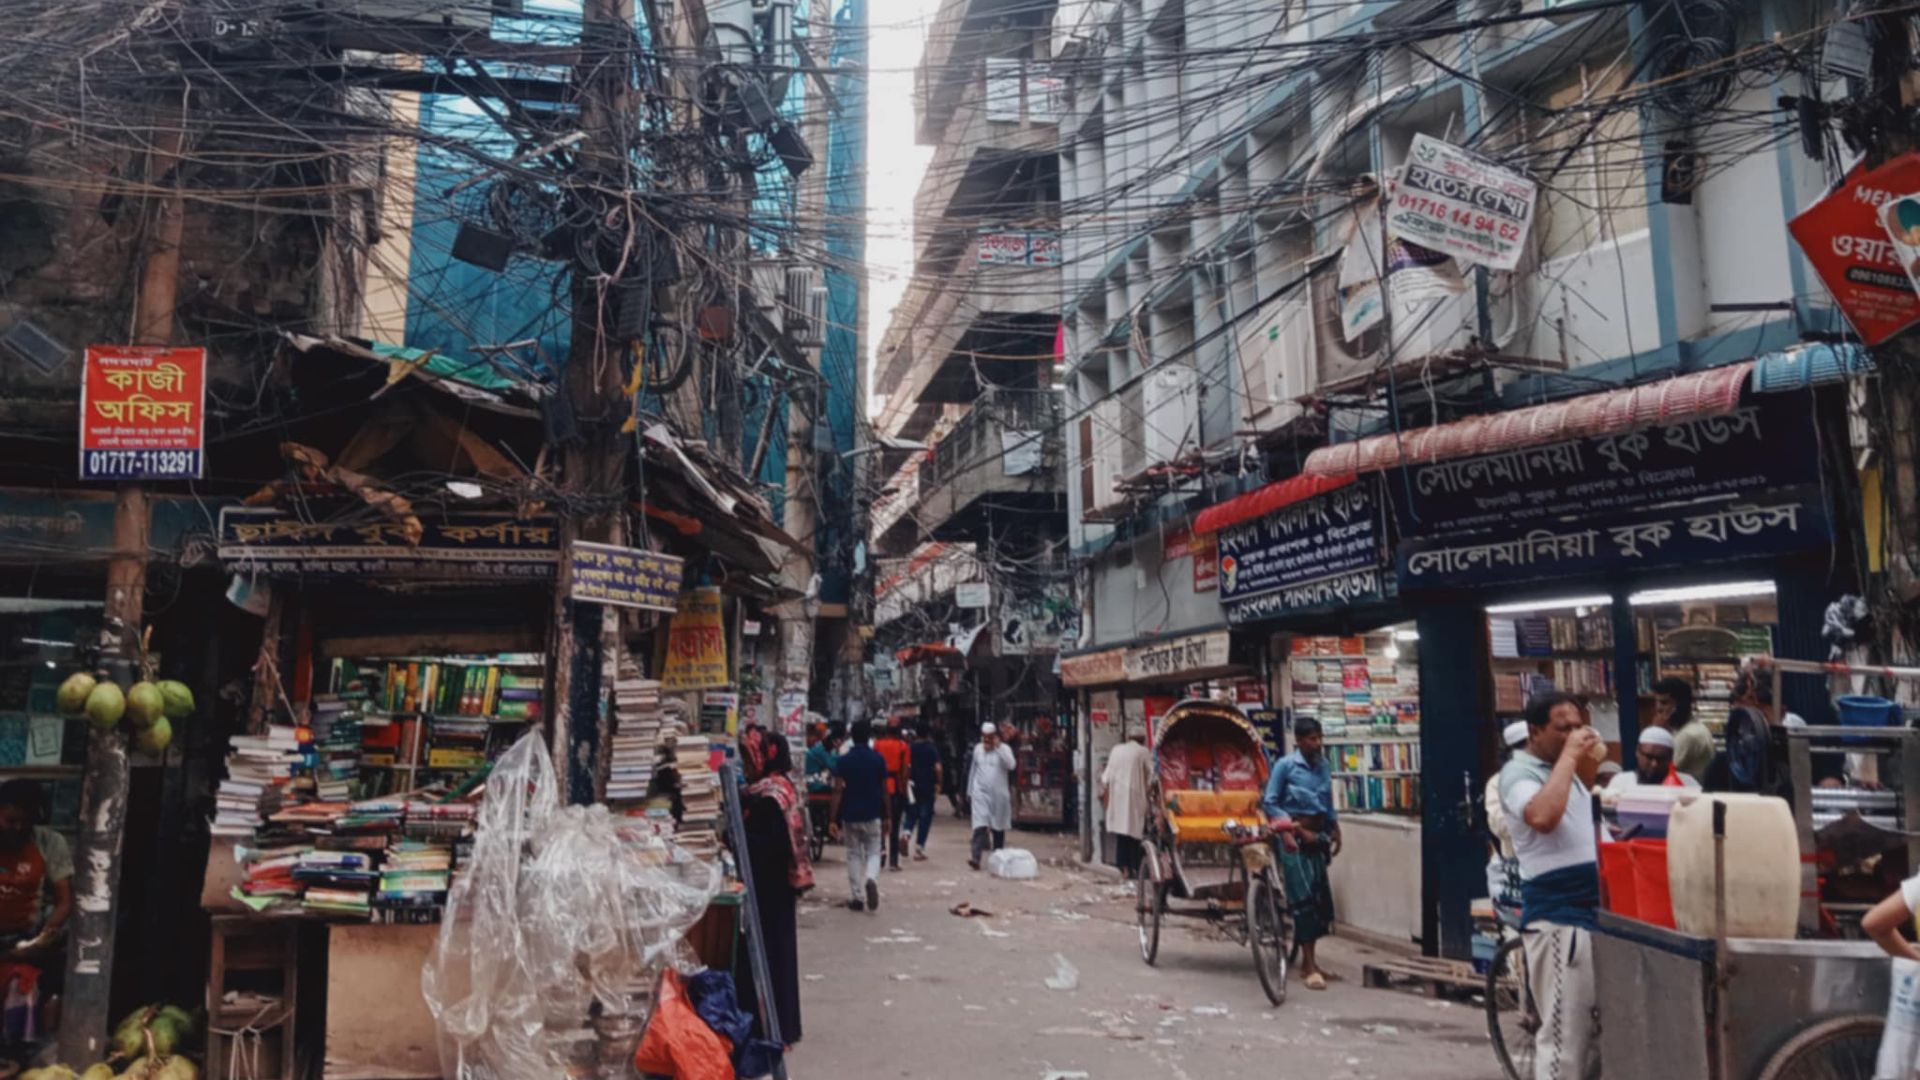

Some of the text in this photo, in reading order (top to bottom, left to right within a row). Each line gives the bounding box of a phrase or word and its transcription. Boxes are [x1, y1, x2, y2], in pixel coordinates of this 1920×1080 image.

[1408, 167, 1473, 201] হাতের
[1475, 186, 1527, 219] লেখা
[1452, 209, 1471, 226] 14
[102, 362, 187, 393] কাজী
[93, 393, 193, 423] অফিস
[90, 451, 194, 474] 01717-113291
[1408, 529, 1602, 575] সোলেমানিয়া
[1607, 520, 1675, 558] বুক
[1683, 502, 1803, 543] হাউস
